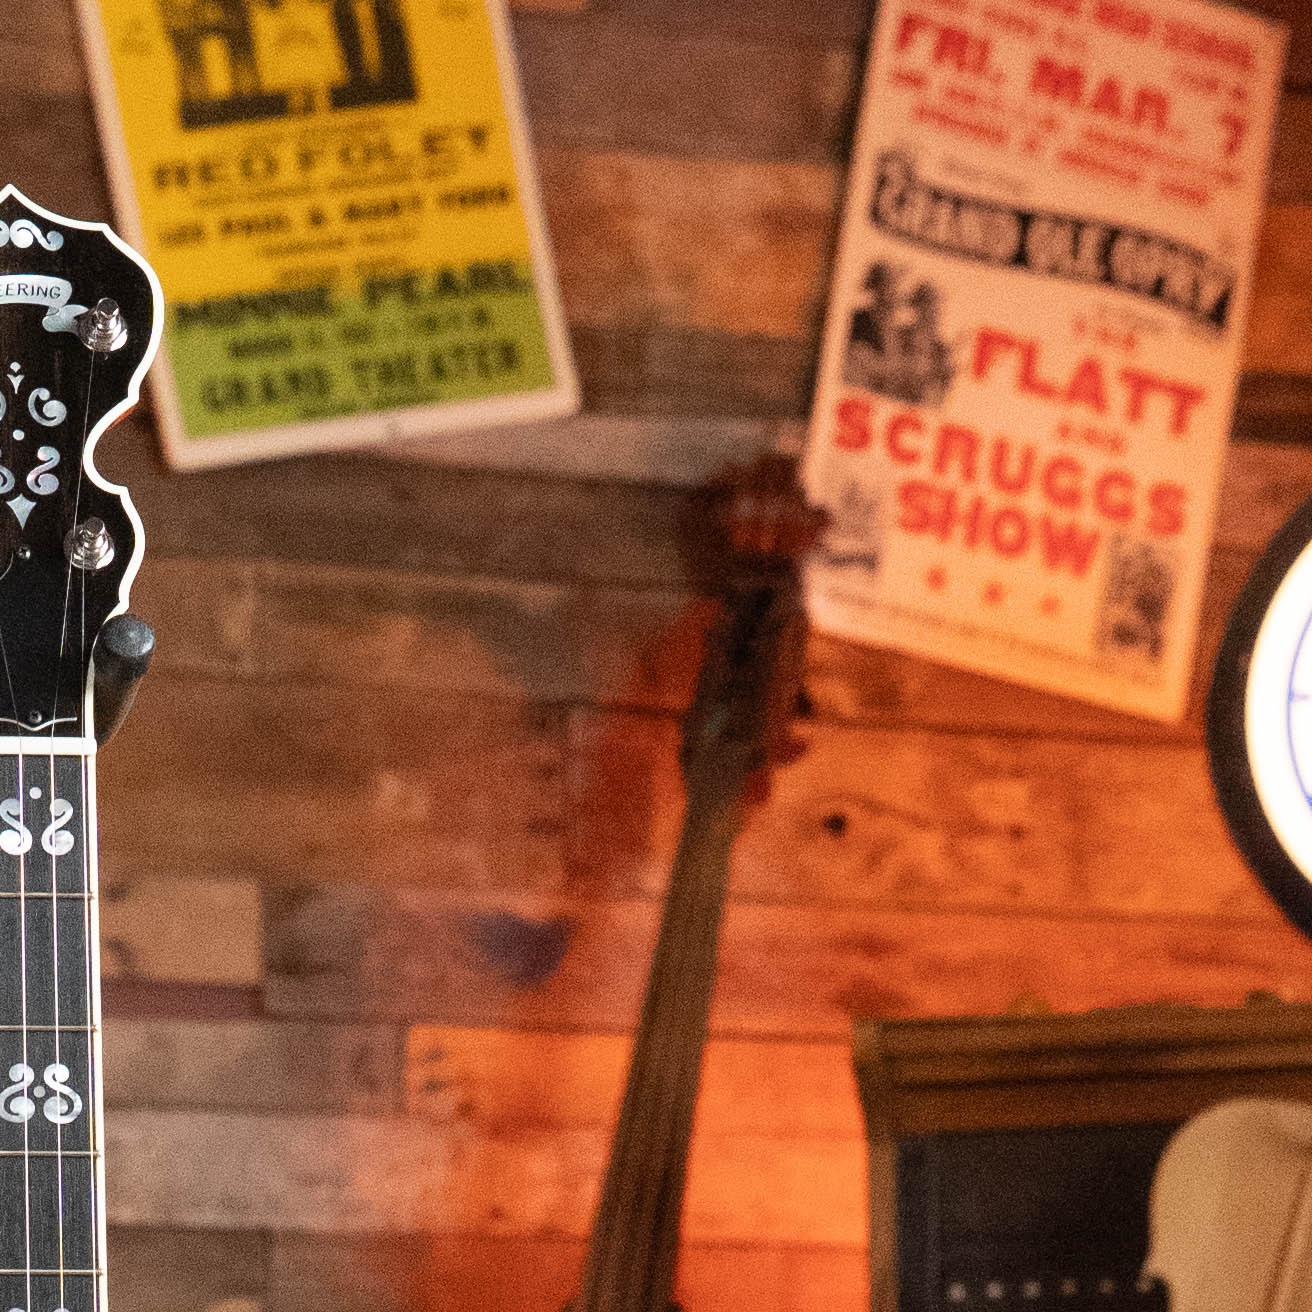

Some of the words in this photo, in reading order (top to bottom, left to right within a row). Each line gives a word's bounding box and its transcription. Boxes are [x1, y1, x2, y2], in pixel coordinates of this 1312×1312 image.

[1029, 55, 1184, 140] MAR.
[972, 327, 1207, 438] FLATT
[833, 397, 1188, 538] SCRUGGS
[897, 480, 1102, 578] SHOW
